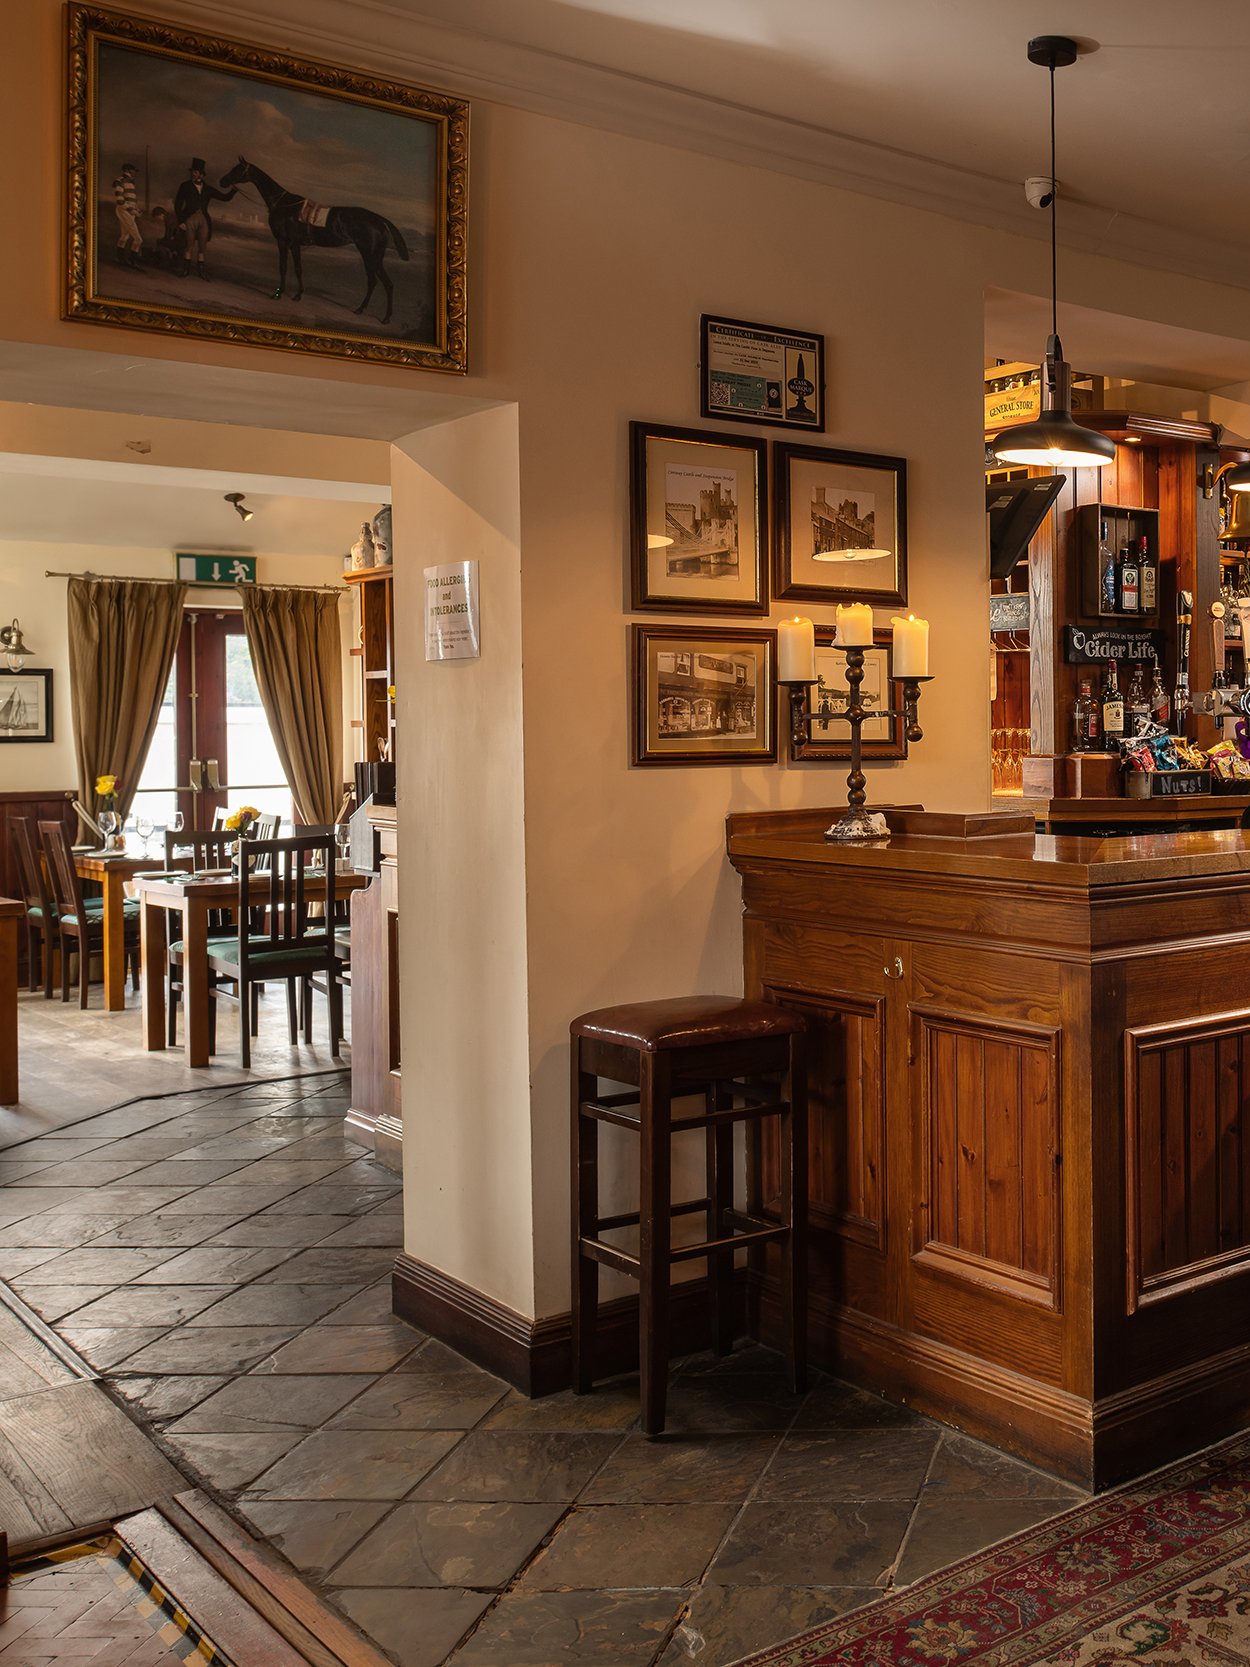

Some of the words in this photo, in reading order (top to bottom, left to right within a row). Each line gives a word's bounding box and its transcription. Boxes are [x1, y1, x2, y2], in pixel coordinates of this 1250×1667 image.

[773, 335, 811, 349] EXCELLENCE
[793, 378, 808, 386] CASK
[989, 402, 1015, 417] GENERAL
[1016, 400, 1034, 410] STORE
[442, 591, 451, 601] and
[430, 603, 468, 617] INTOLERANCES
[1084, 640, 1126, 658] Cider
[1127, 641, 1155, 659] Life
